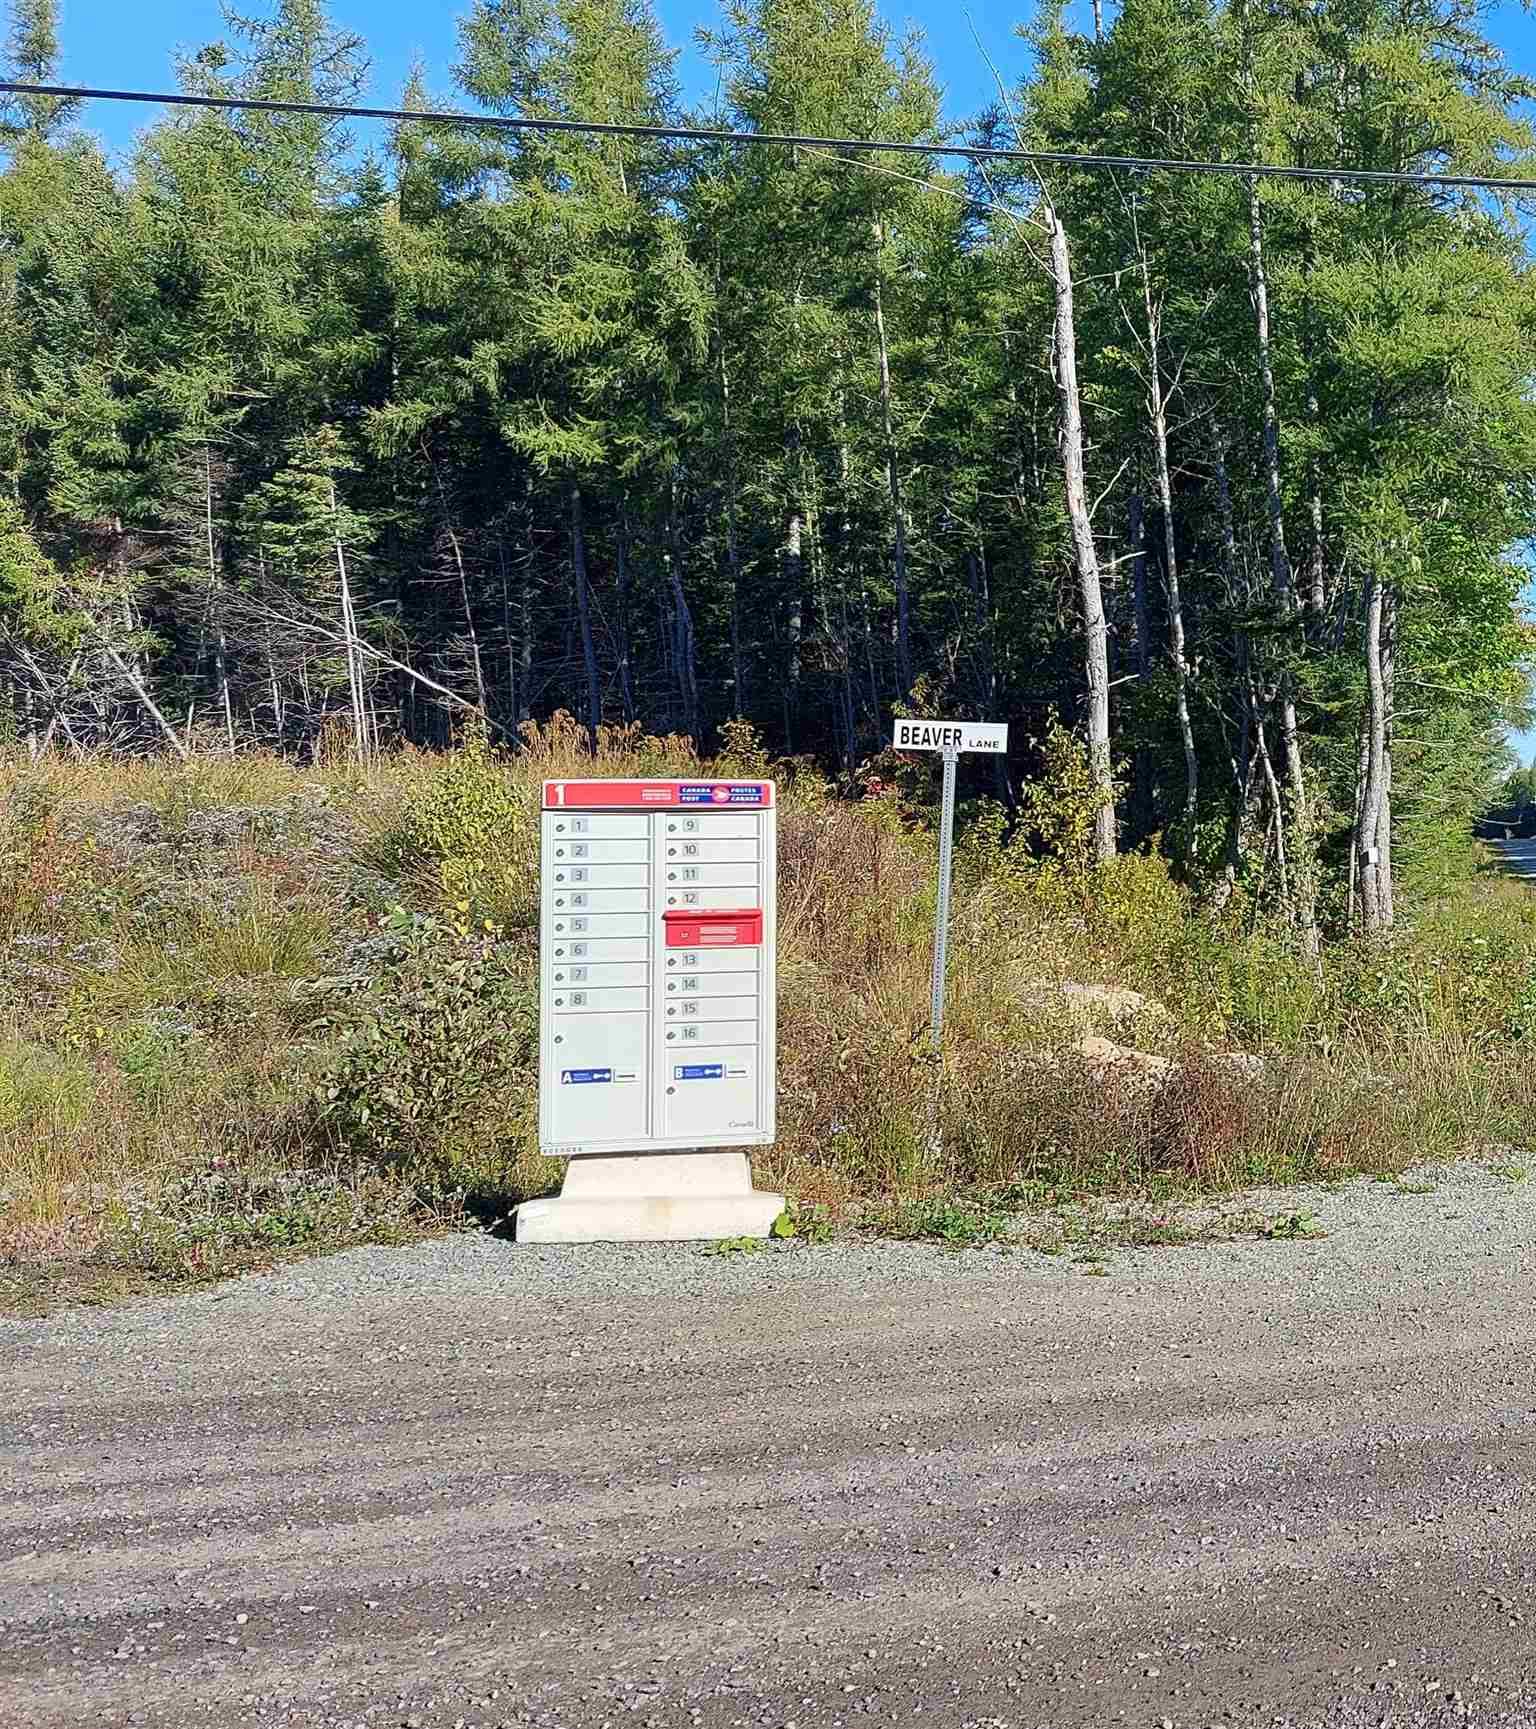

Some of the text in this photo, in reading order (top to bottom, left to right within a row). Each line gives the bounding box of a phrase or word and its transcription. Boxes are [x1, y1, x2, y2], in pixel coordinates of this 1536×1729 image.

[900, 726, 1000, 749] BEAVER LANE
[554, 785, 565, 806] 1
[576, 821, 582, 830] 1
[686, 820, 694, 830] 9
[575, 846, 583, 856] 2
[685, 845, 696, 854] 10
[575, 870, 583, 881] 3
[685, 869, 696, 879] 11
[573, 895, 582, 905] 4
[685, 894, 696, 903] 12
[575, 920, 582, 930] 5
[574, 945, 582, 954] 6
[684, 955, 696, 965] 13
[575, 970, 582, 979] 7
[684, 979, 696, 989] 14
[574, 994, 581, 1005] 8
[684, 1003, 696, 1013] 15
[684, 1028, 696, 1038] 16
[562, 1072, 573, 1083] A
[675, 1068, 684, 1078] B
